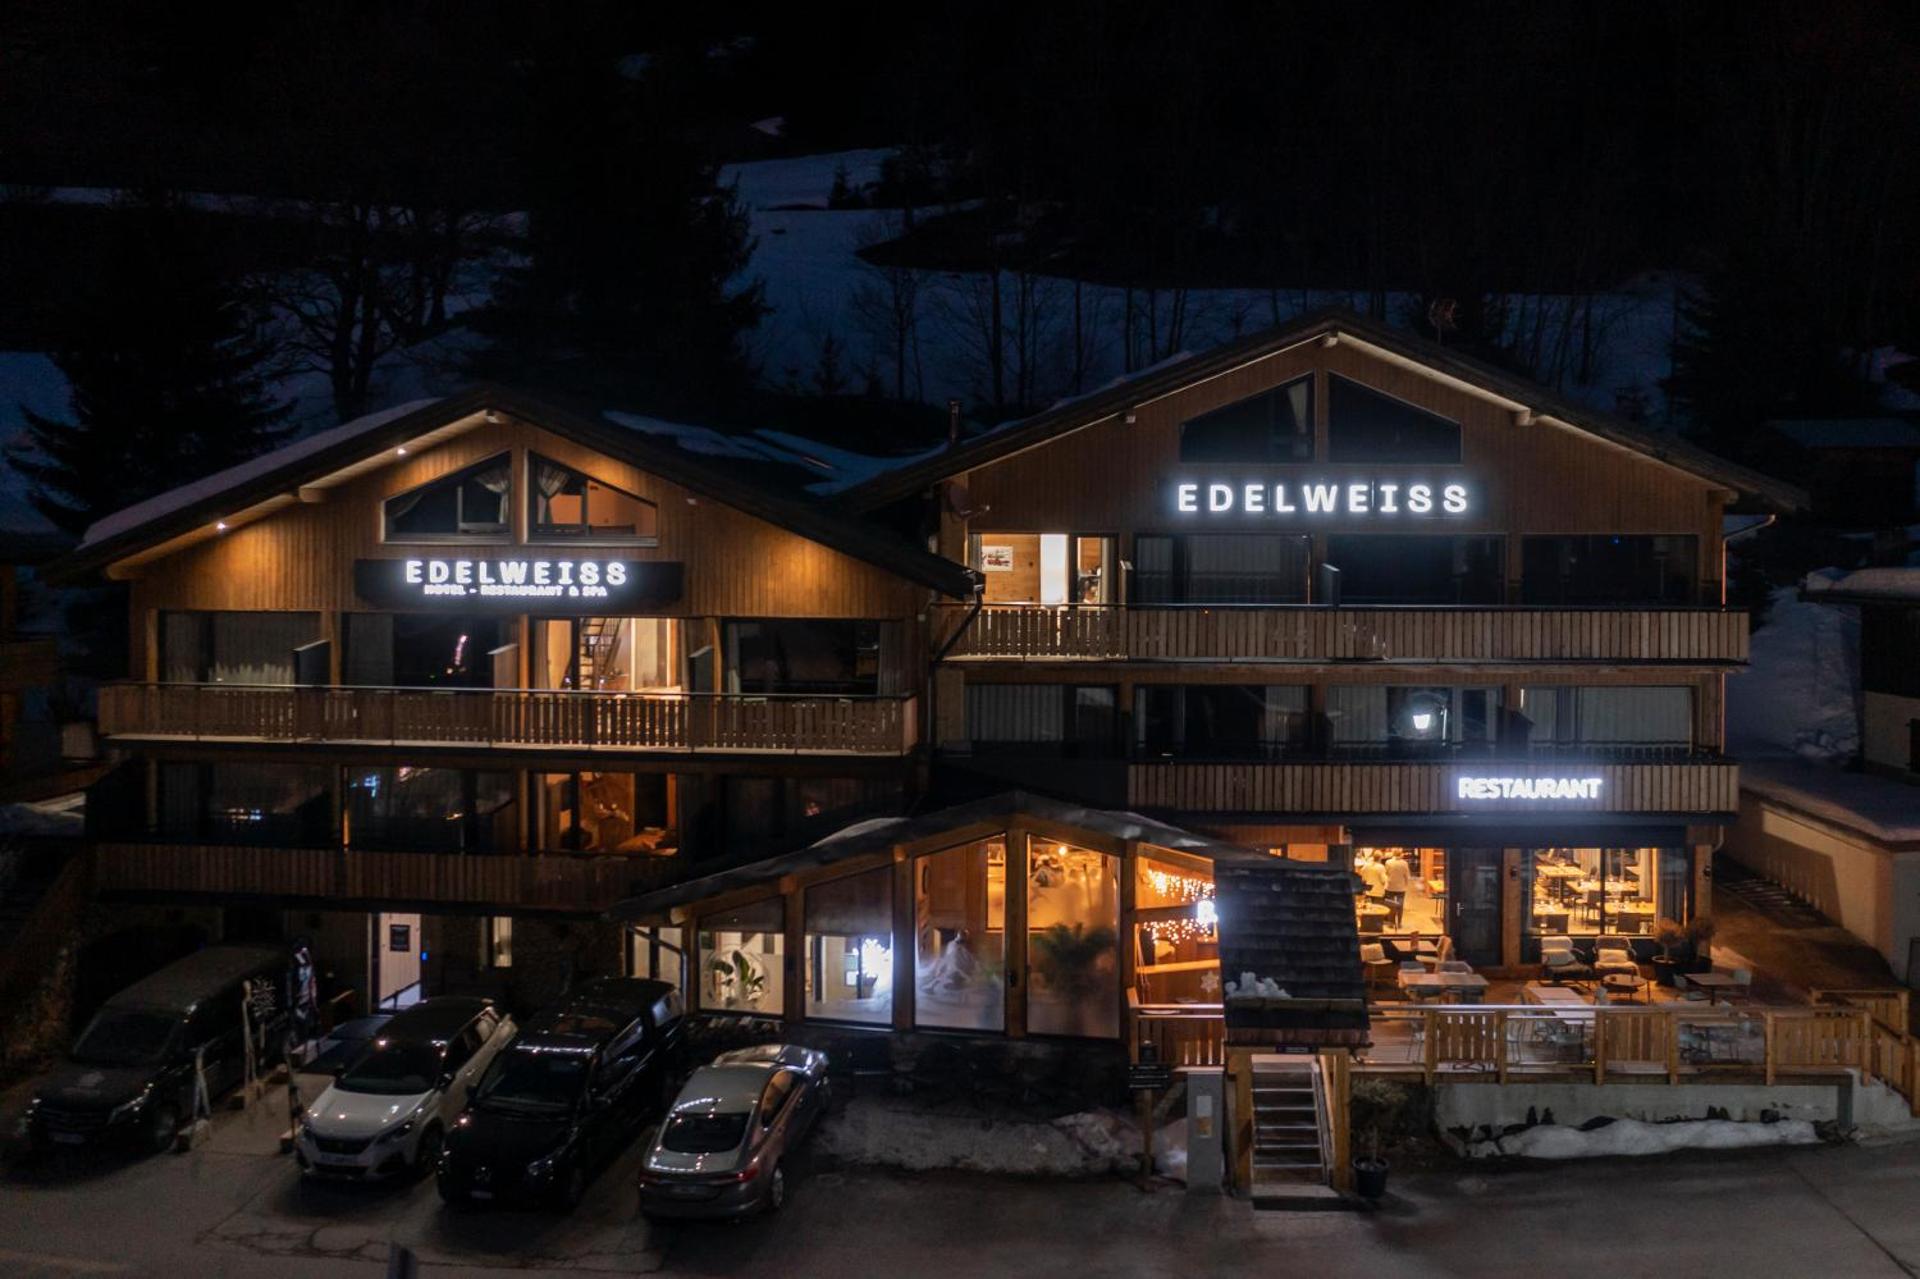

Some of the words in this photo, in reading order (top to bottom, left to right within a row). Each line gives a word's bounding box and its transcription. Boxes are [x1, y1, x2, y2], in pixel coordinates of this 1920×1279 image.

[1178, 484, 1467, 512] EDELWEISS
[406, 560, 627, 585] EDELWEISS
[424, 585, 466, 595] HOTEL
[582, 586, 608, 597] SPA
[1458, 777, 1603, 799] RESTAURANT
